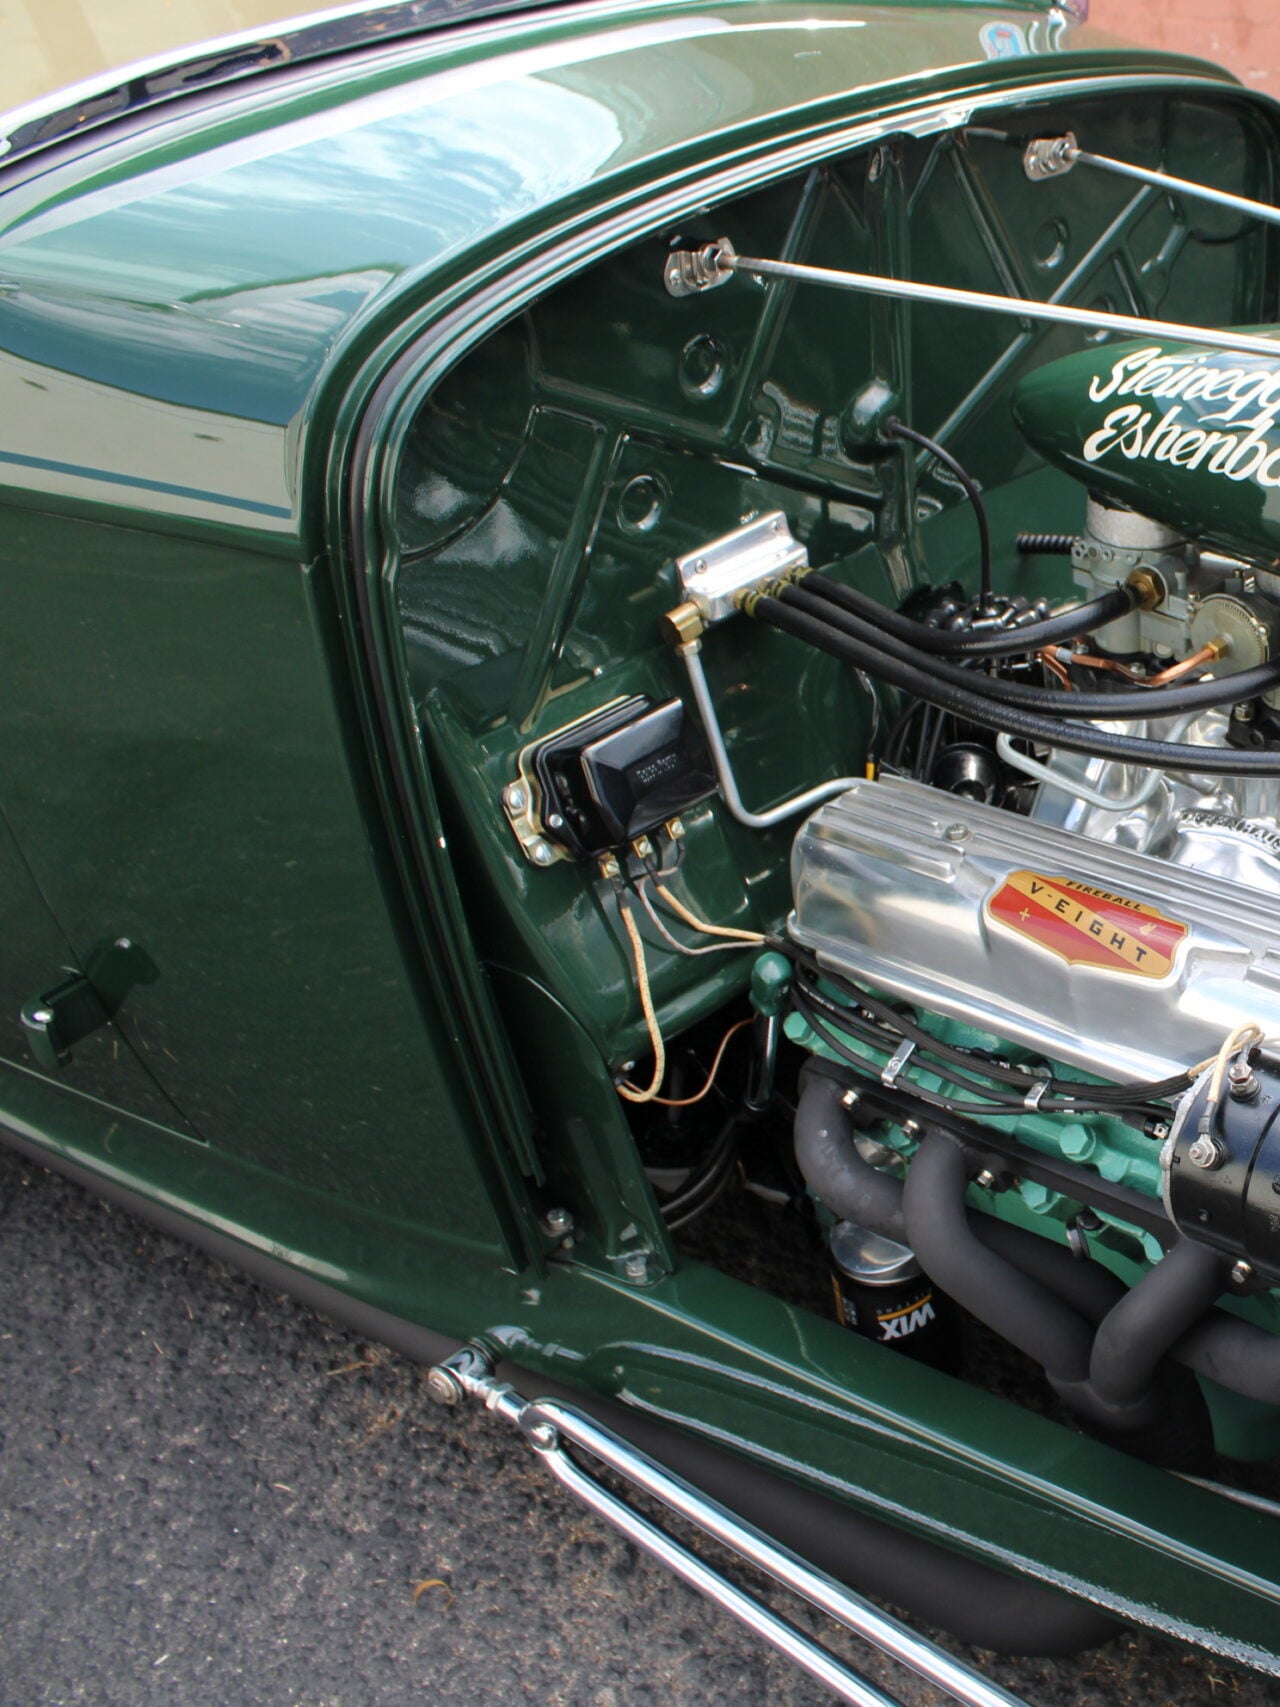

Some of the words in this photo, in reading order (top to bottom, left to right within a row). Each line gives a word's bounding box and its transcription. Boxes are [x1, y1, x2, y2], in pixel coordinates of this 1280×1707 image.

[1066, 880, 1142, 911] FIREBALL
[1030, 881, 1147, 963] V-EIGHT
[879, 1302, 936, 1341] WIX
